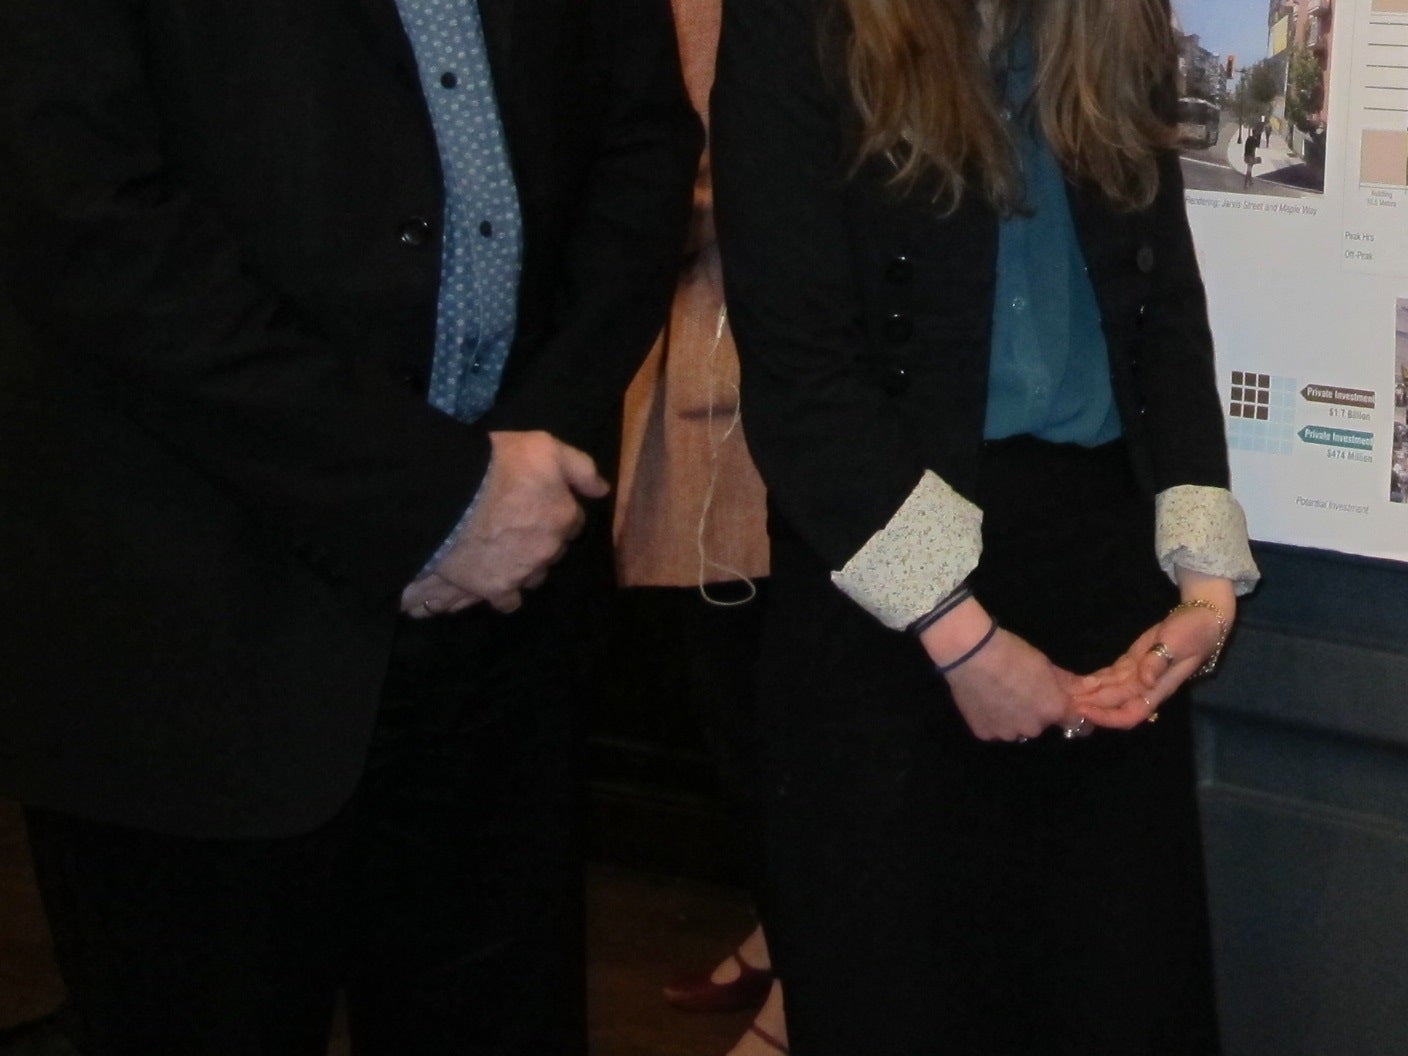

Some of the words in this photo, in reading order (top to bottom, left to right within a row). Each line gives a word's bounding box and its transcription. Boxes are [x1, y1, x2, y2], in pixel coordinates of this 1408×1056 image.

[1243, 201, 1264, 210] Street
[1280, 204, 1301, 215] Maple
[1302, 206, 1317, 216] Way
[1307, 387, 1333, 399] Private
[1304, 429, 1331, 441] Private
[1328, 500, 1369, 514] Investment
